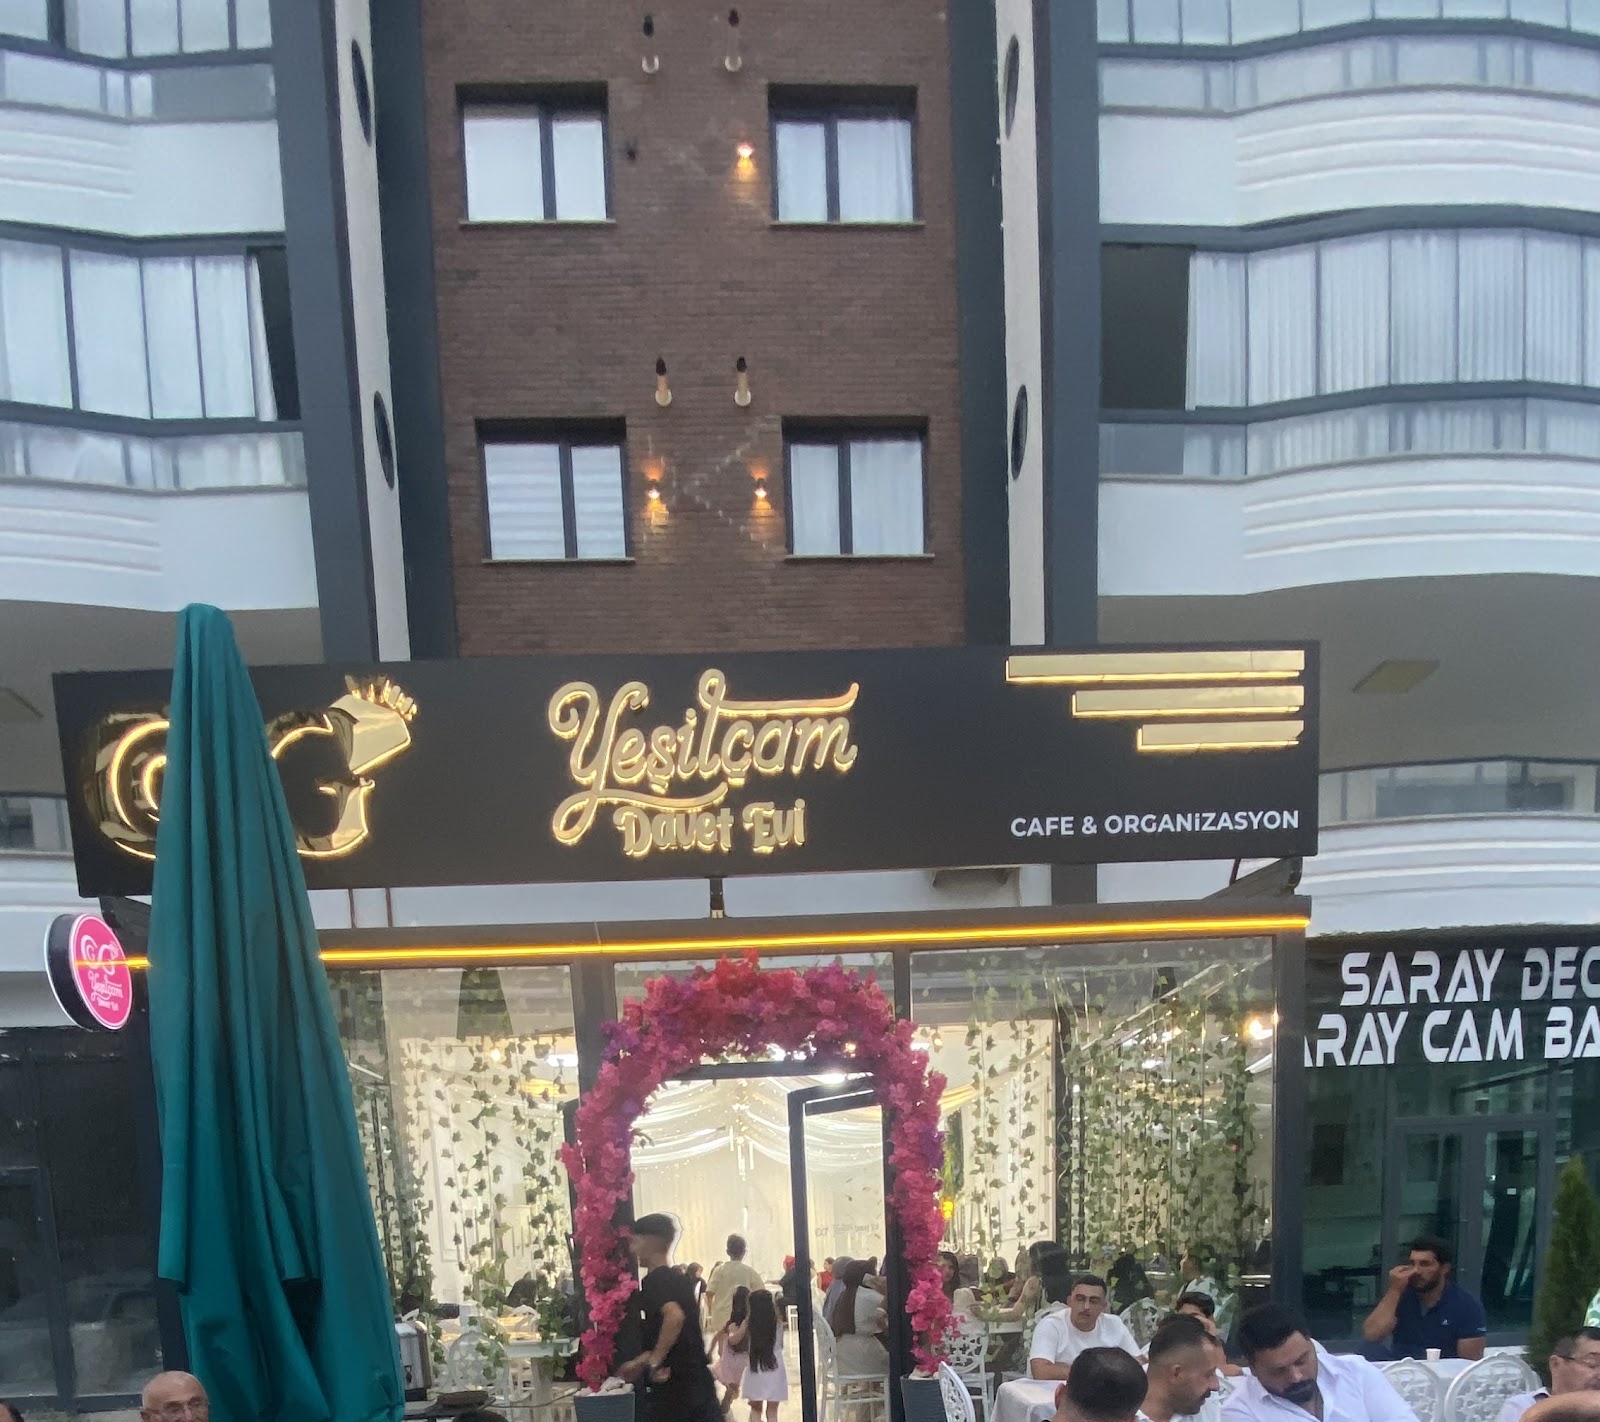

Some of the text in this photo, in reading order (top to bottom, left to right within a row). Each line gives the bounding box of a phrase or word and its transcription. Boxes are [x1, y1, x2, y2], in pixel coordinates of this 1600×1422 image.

[549, 668, 859, 846] Yeşilçam
[612, 798, 806, 857] Davet Evi
[1010, 816, 1075, 837] CAFE
[1081, 816, 1098, 835] &
[1340, 949, 1505, 1006] SARAY
[1304, 1011, 1409, 1067] RAY
[1422, 1007, 1524, 1063] CAM
